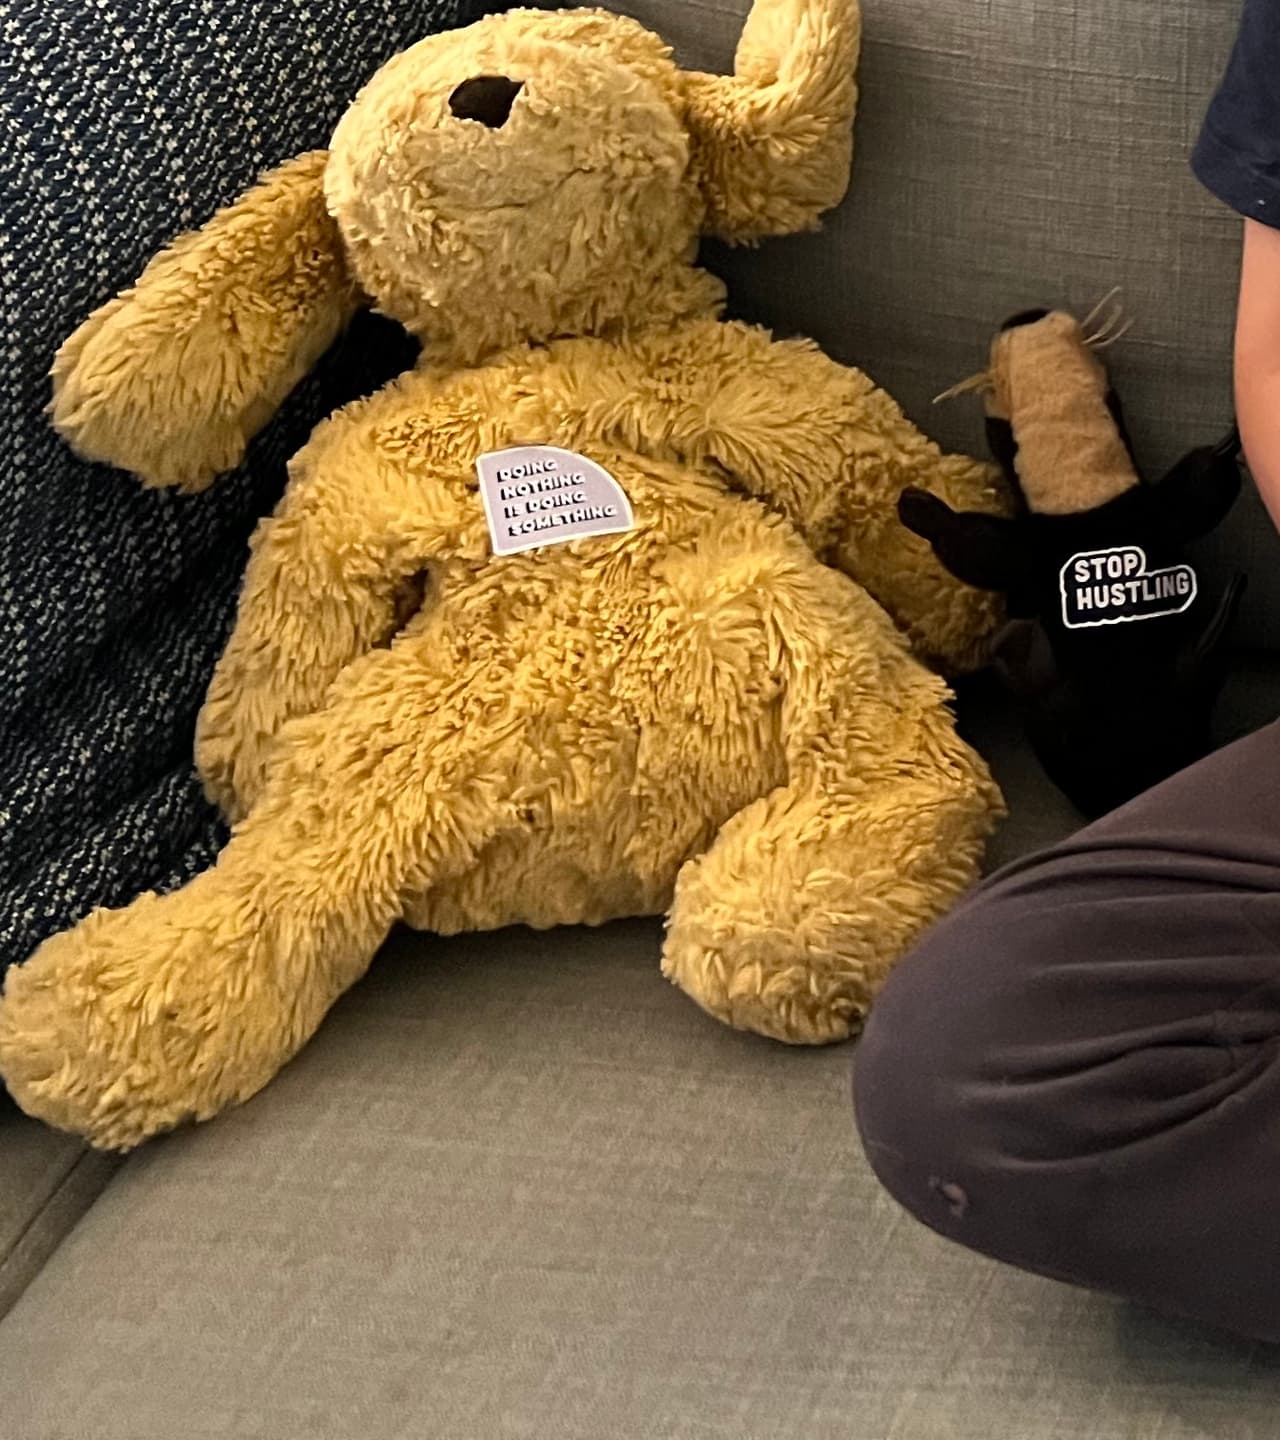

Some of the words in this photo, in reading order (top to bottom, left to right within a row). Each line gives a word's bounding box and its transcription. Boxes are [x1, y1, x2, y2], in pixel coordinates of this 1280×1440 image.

[497, 459, 559, 483] DOING
[500, 472, 586, 501] NOTHING
[504, 504, 524, 519] IS
[526, 490, 587, 513] DOING
[508, 505, 617, 536] SOMETHING
[1075, 554, 1138, 582] STOP
[1076, 572, 1190, 611] HUSTLING
